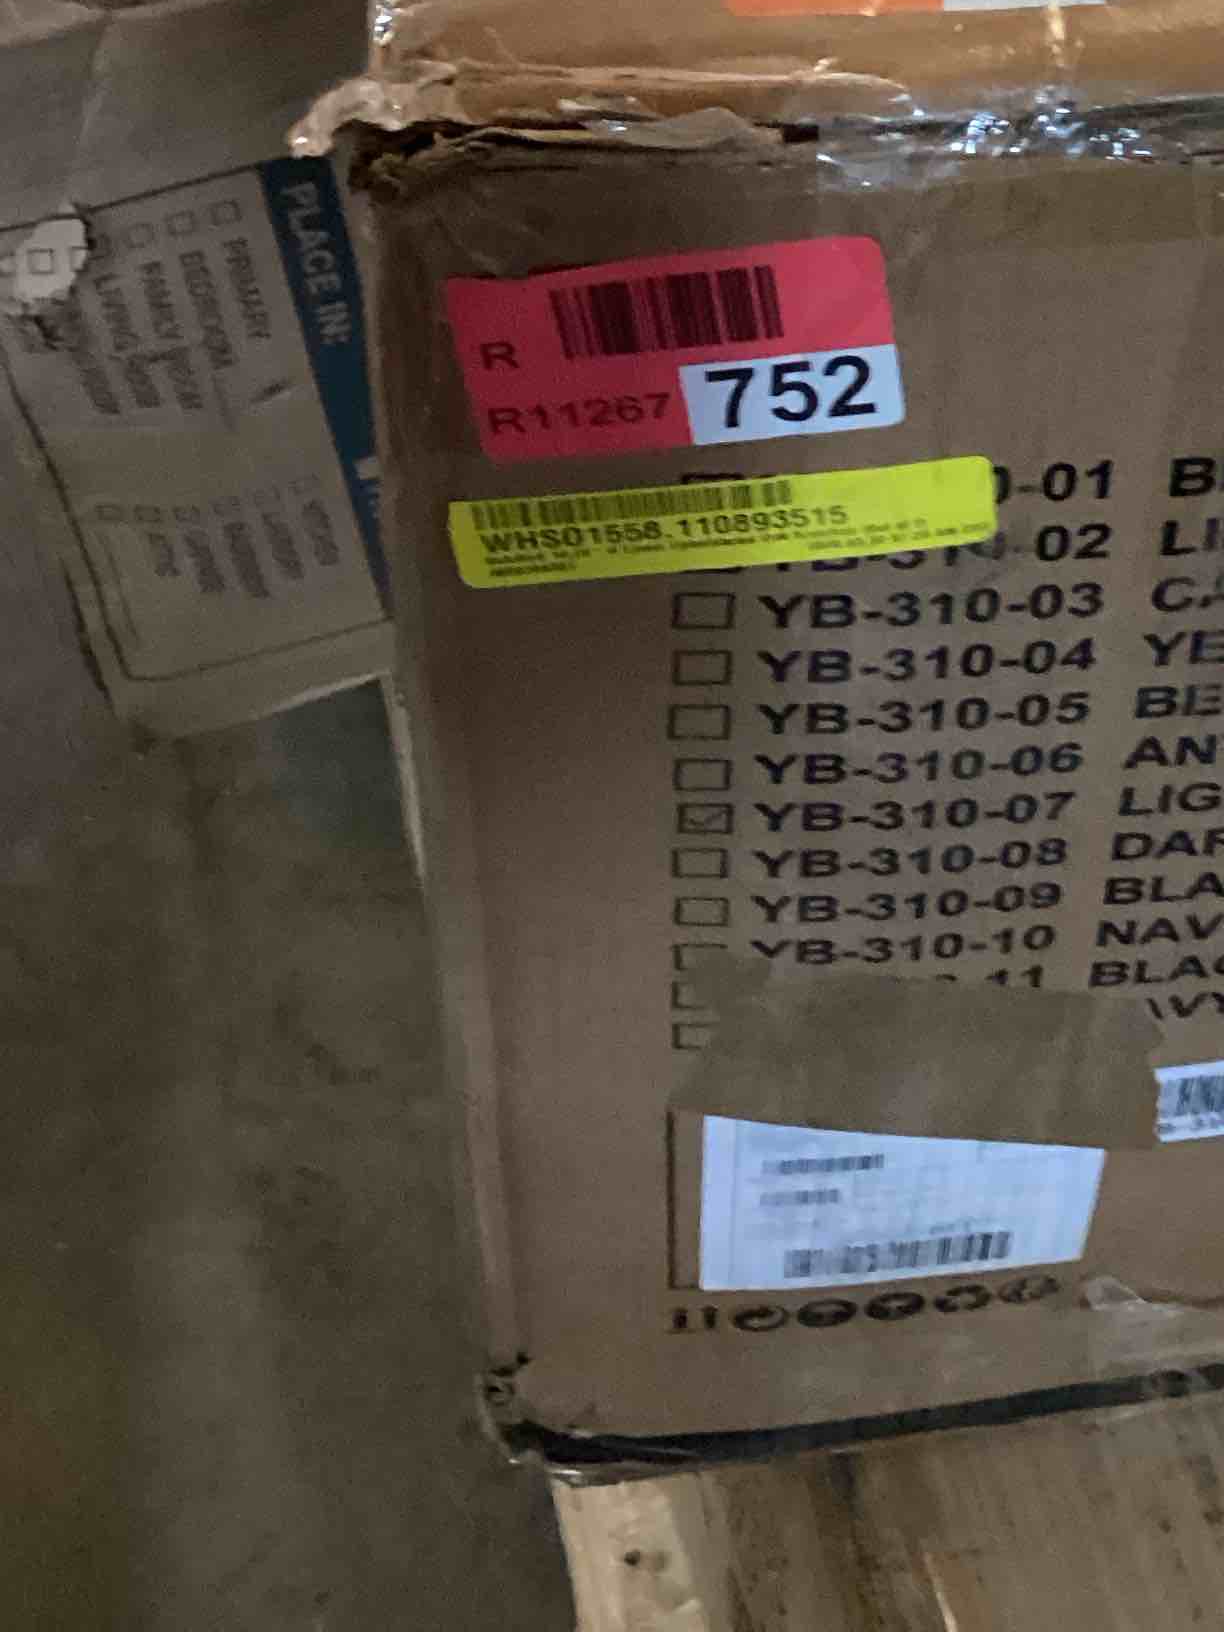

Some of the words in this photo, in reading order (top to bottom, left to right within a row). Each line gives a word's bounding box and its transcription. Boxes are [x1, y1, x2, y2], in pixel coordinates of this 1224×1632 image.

[281, 180, 339, 295] PLACE
[480, 340, 519, 370] R
[488, 391, 671, 436] R11267
[704, 354, 878, 430] 752
[757, 581, 1105, 629] YB-310-03
[756, 637, 1098, 684] YB-310-04
[756, 691, 1090, 735] YB-310-05
[753, 741, 1084, 785] YB-310-06
[753, 791, 1077, 832] YB-310-07
[751, 837, 1068, 878] YB-310-08
[749, 881, 1063, 924] YB-310-09
